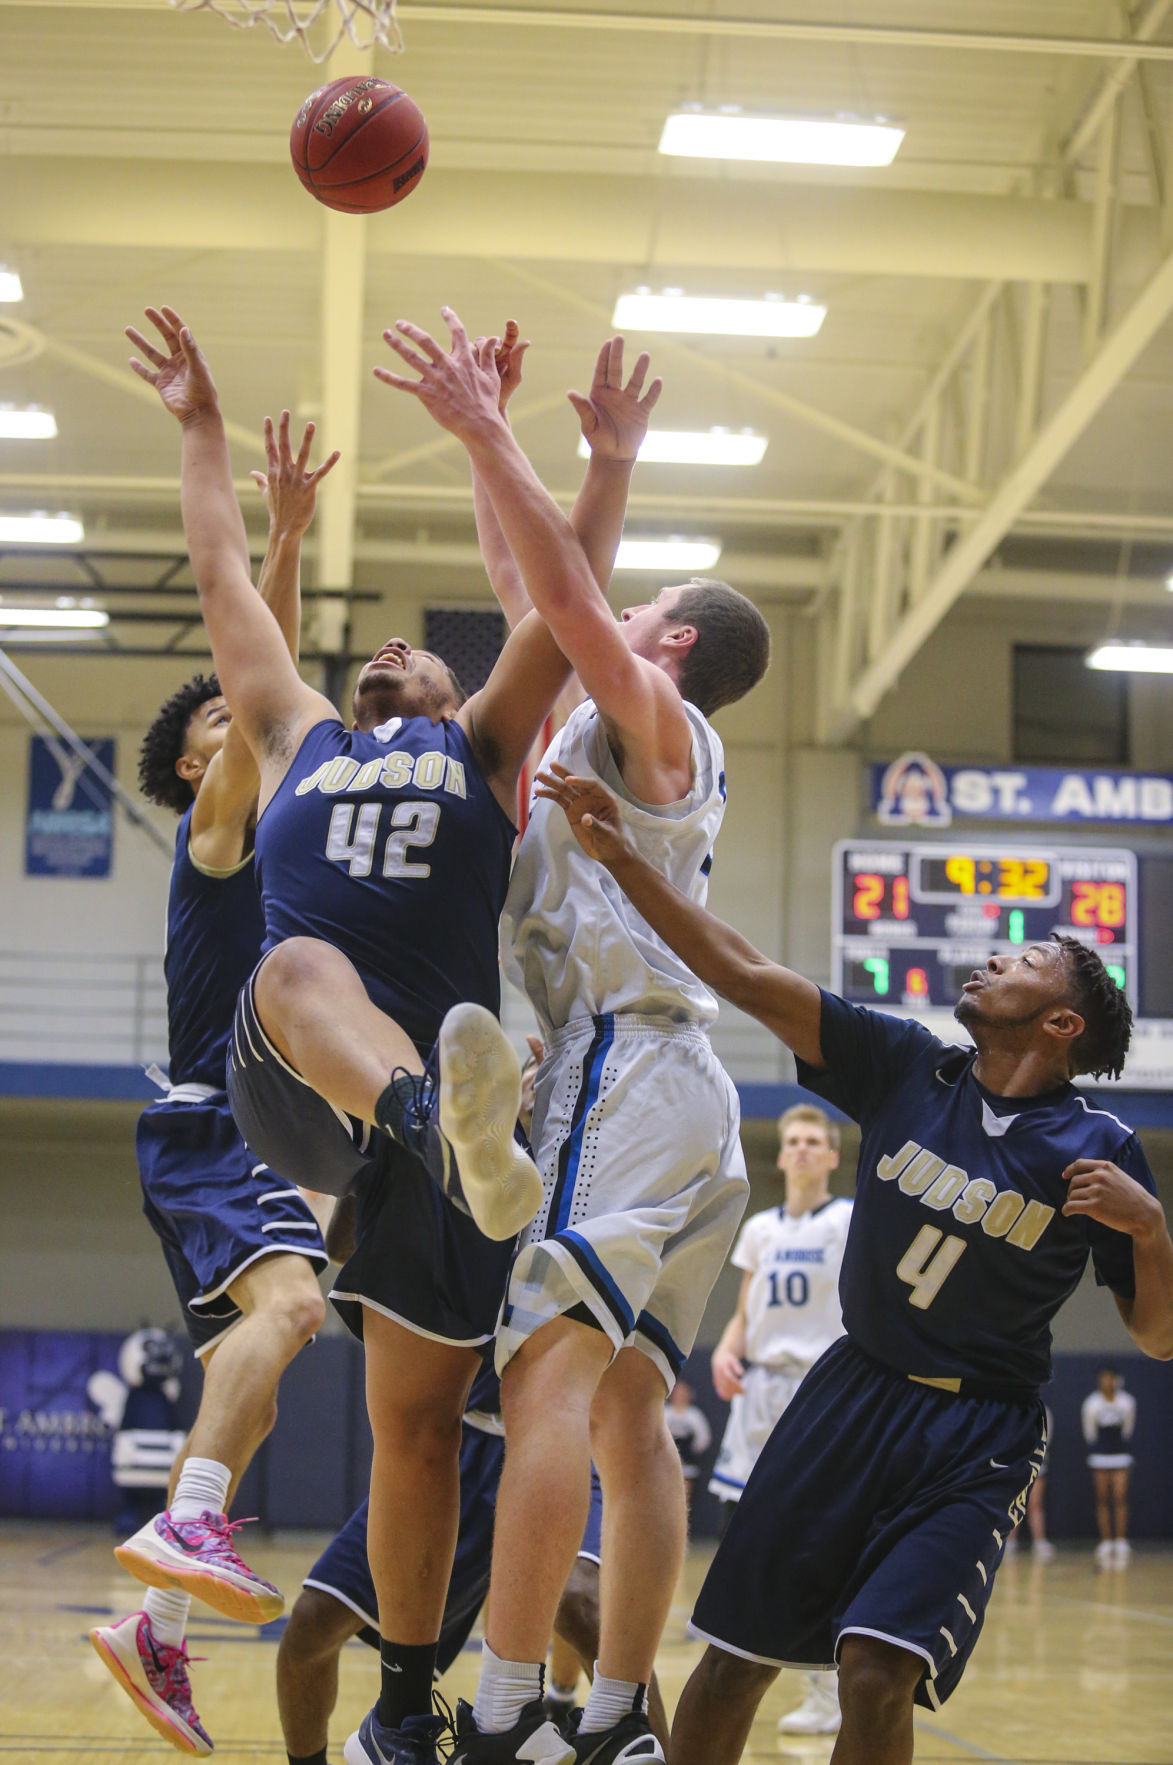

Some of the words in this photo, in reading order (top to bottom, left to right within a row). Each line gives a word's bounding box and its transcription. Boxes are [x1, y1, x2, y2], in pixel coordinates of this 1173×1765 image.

[295, 750, 467, 800] JUDSON
[952, 769, 1033, 815] ST.
[325, 801, 441, 878] 42
[853, 872, 909, 920] 21
[945, 854, 1050, 901] 9:32
[1070, 880, 1126, 928] 28
[876, 1139, 1056, 1251] JUDSON
[767, 1271, 810, 1308] 10
[896, 1223, 968, 1310] 4
